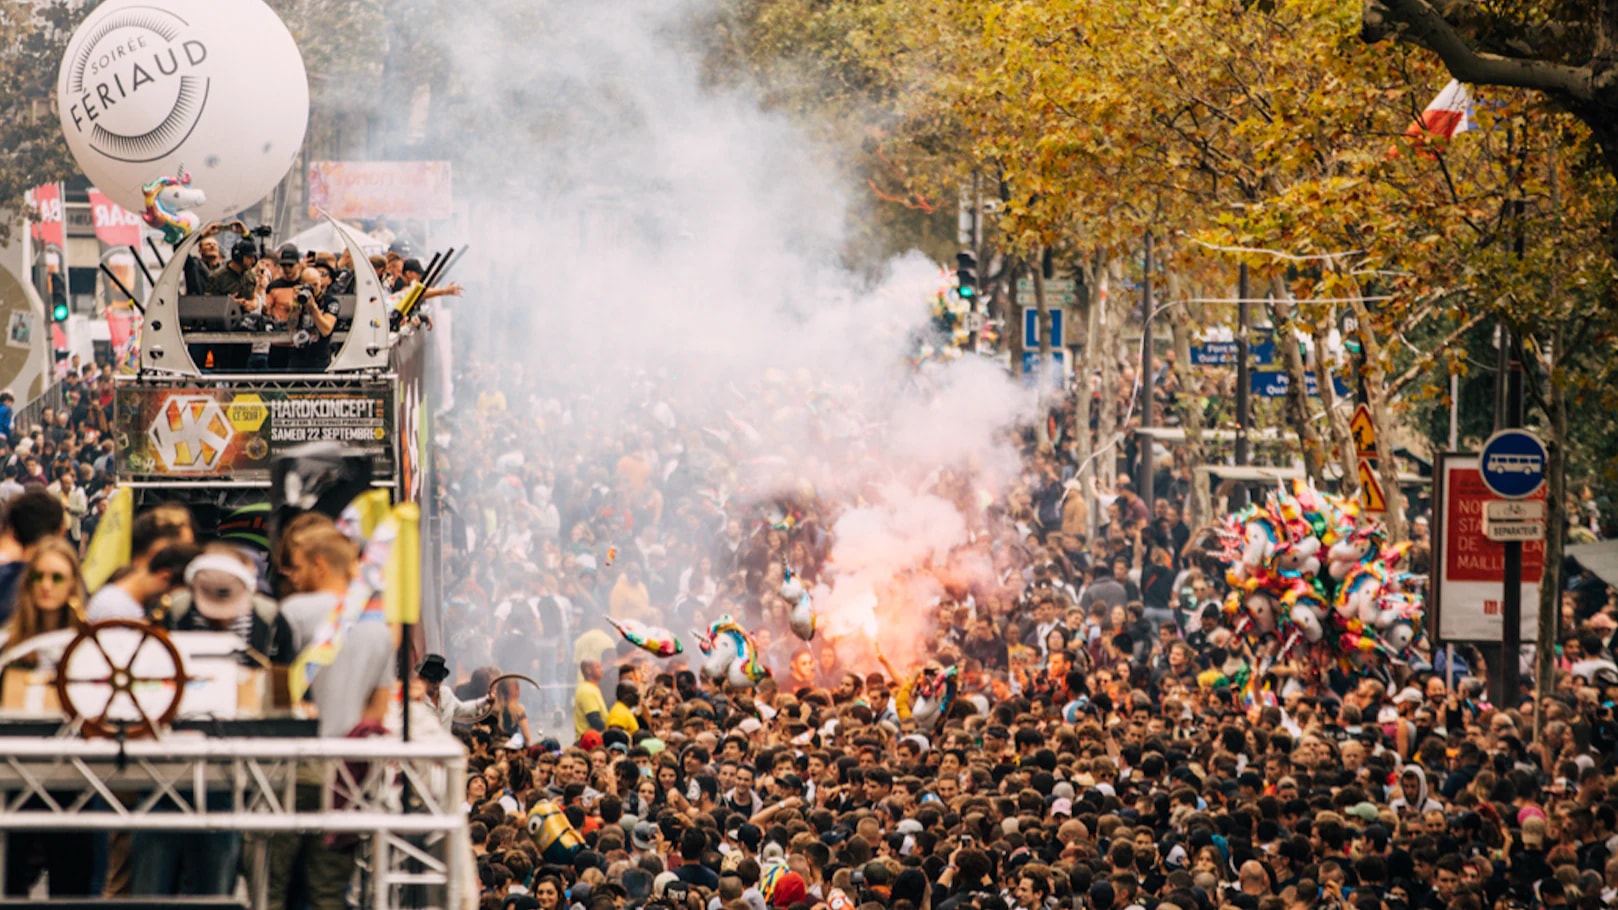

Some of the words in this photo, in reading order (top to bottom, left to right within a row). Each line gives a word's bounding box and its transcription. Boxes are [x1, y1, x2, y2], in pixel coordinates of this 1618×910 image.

[91, 35, 147, 75] SOIRÉE
[70, 40, 207, 132] FÉRIAUD
[271, 399, 376, 418] HARDKONCEPT
[271, 428, 306, 440] SAMEDI
[307, 428, 320, 440] 22
[322, 428, 375, 440] SEPTEMBRE
[1494, 526, 1538, 536] SEPARATEUR
[1458, 537, 1479, 552] DE
[1457, 556, 1504, 570] MAILL
